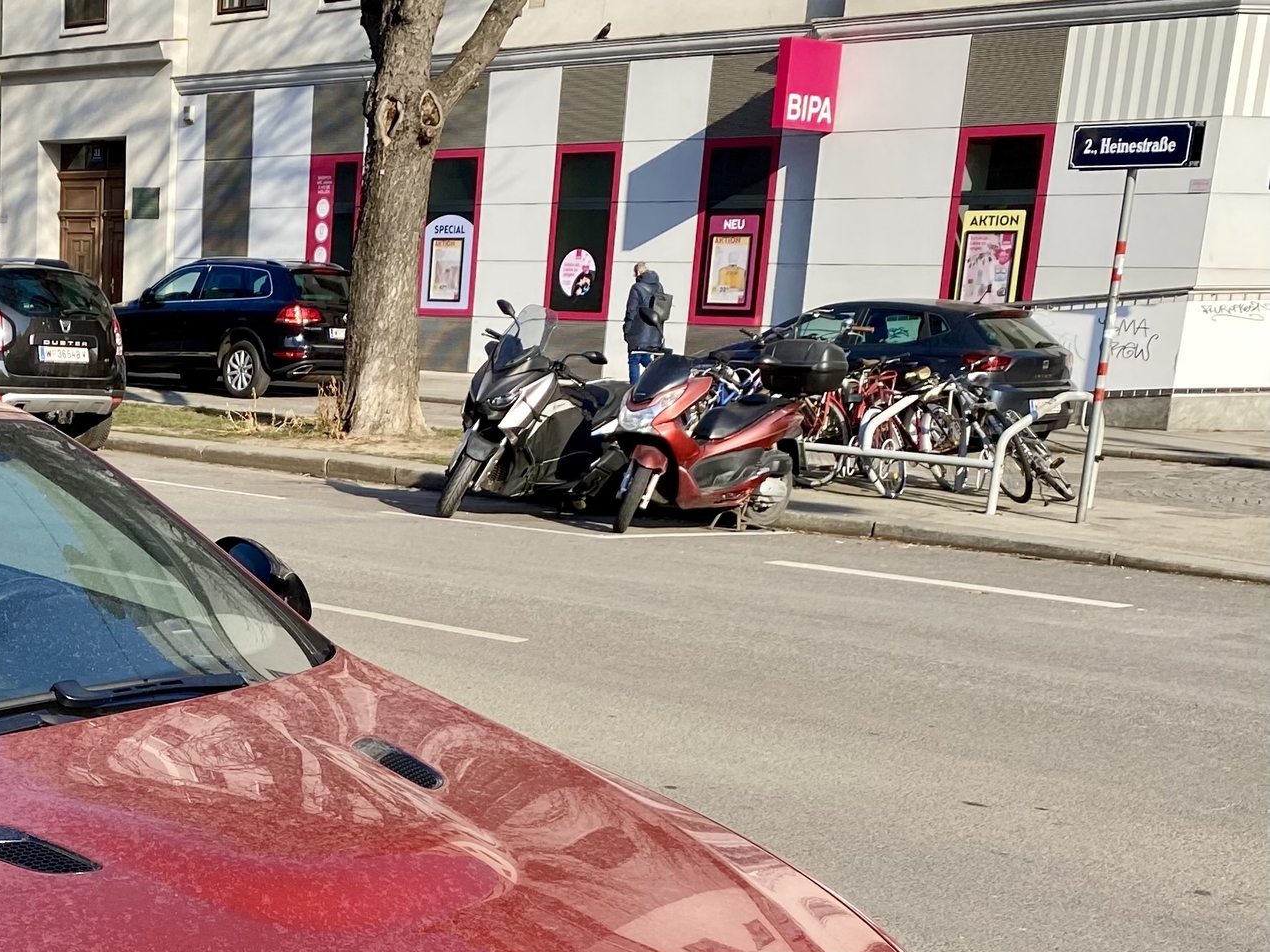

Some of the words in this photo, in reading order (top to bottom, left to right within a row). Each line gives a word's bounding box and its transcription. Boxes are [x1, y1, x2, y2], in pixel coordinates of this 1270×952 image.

[786, 93, 832, 124] BIPA
[1100, 136, 1176, 154] Heinestraße
[723, 218, 745, 230] NEU
[970, 215, 1019, 226] AKTION
[434, 225, 465, 234] SPECIAL
